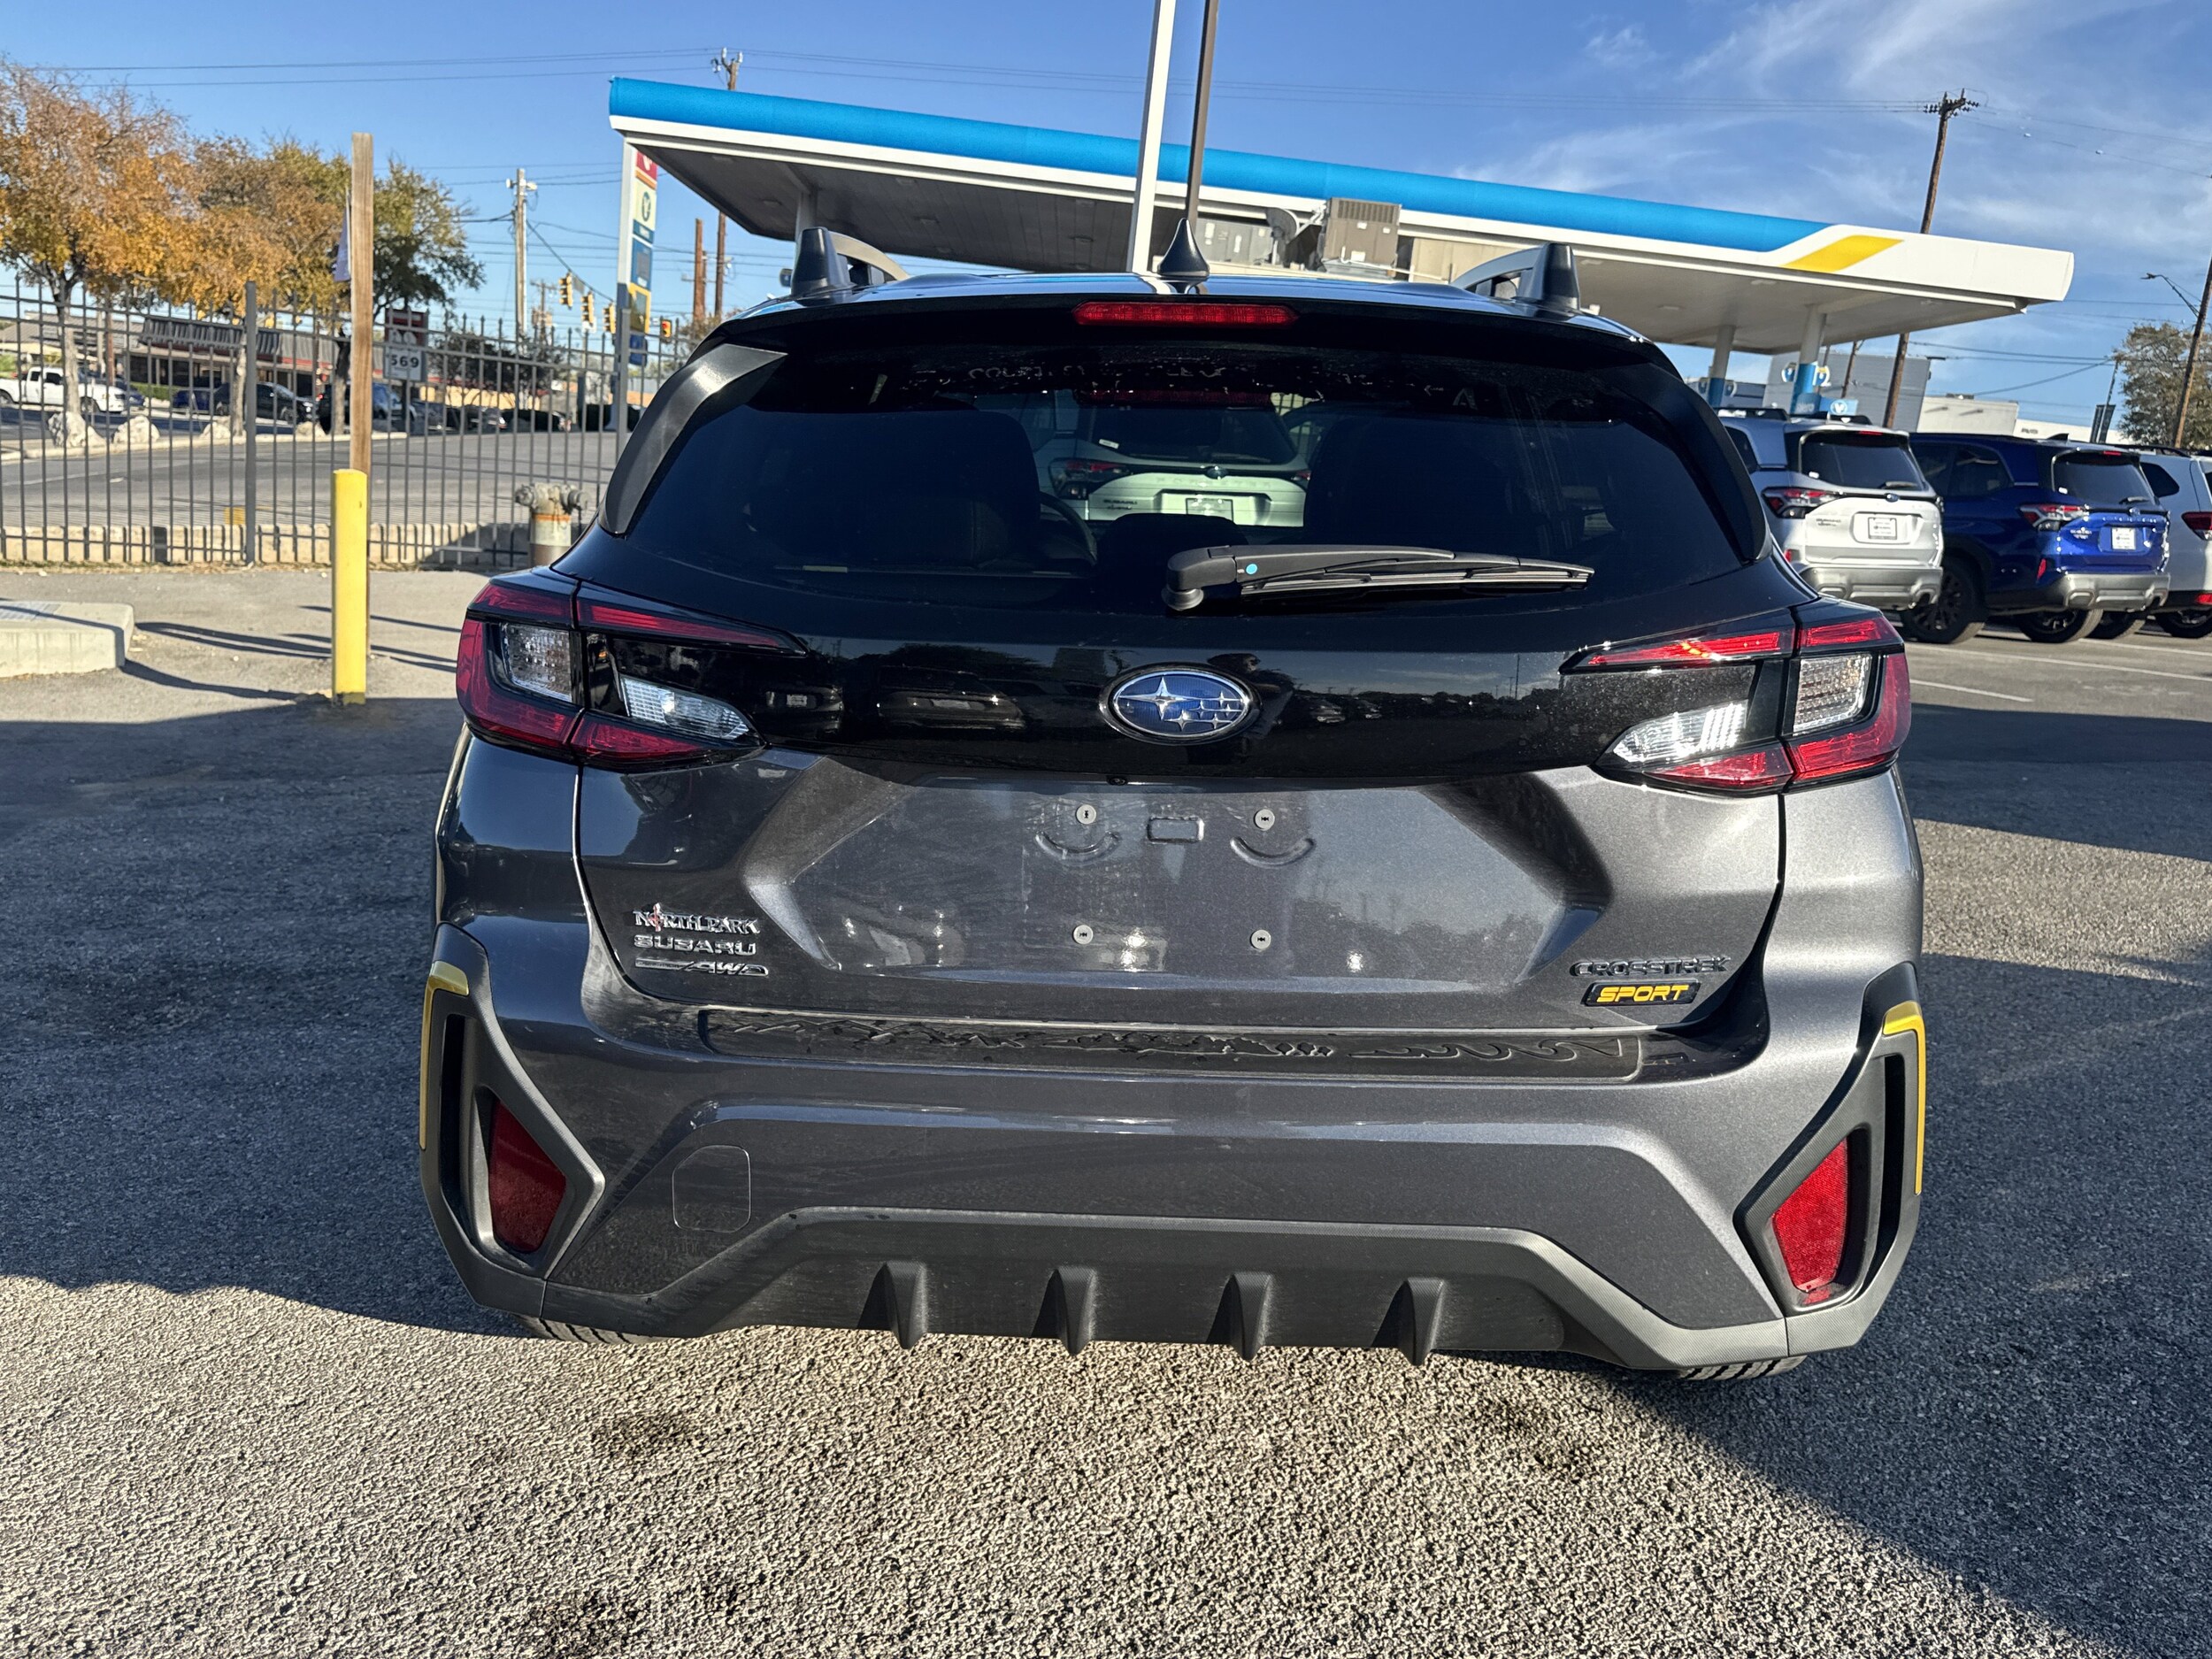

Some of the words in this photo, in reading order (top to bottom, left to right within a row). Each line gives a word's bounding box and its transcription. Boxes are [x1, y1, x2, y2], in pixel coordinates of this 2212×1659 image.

[634, 934, 757, 956] SUBARU
[683, 960, 769, 976] AWD
[1570, 956, 1732, 976] CROSSTREK
[1596, 984, 1690, 1002] SPORT
